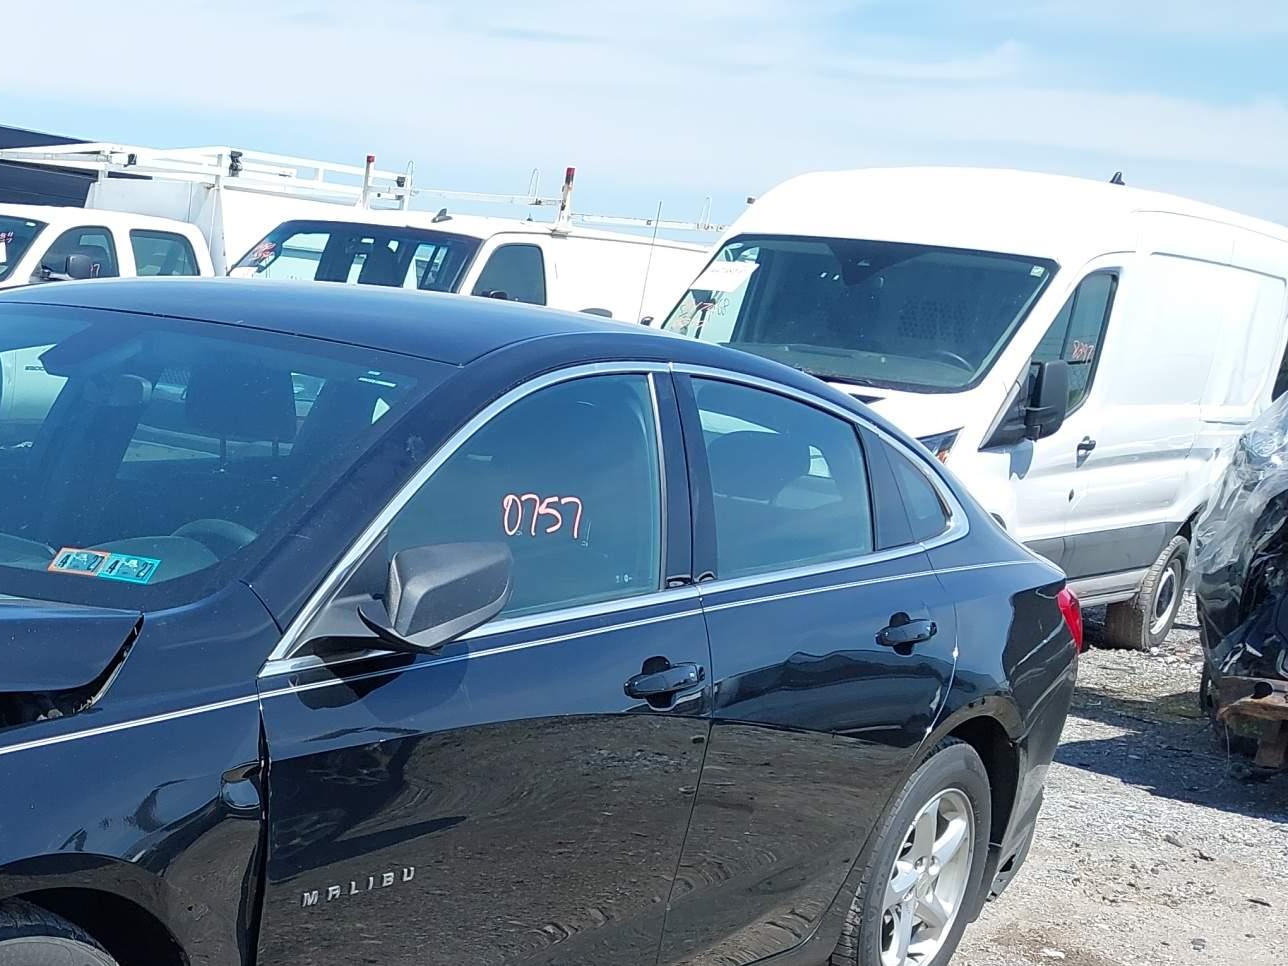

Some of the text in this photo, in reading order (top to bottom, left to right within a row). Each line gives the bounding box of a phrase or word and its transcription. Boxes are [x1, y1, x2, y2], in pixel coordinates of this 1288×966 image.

[503, 493, 583, 539] 0757
[107, 560, 120, 574] 4
[302, 866, 415, 907] MALIBU
